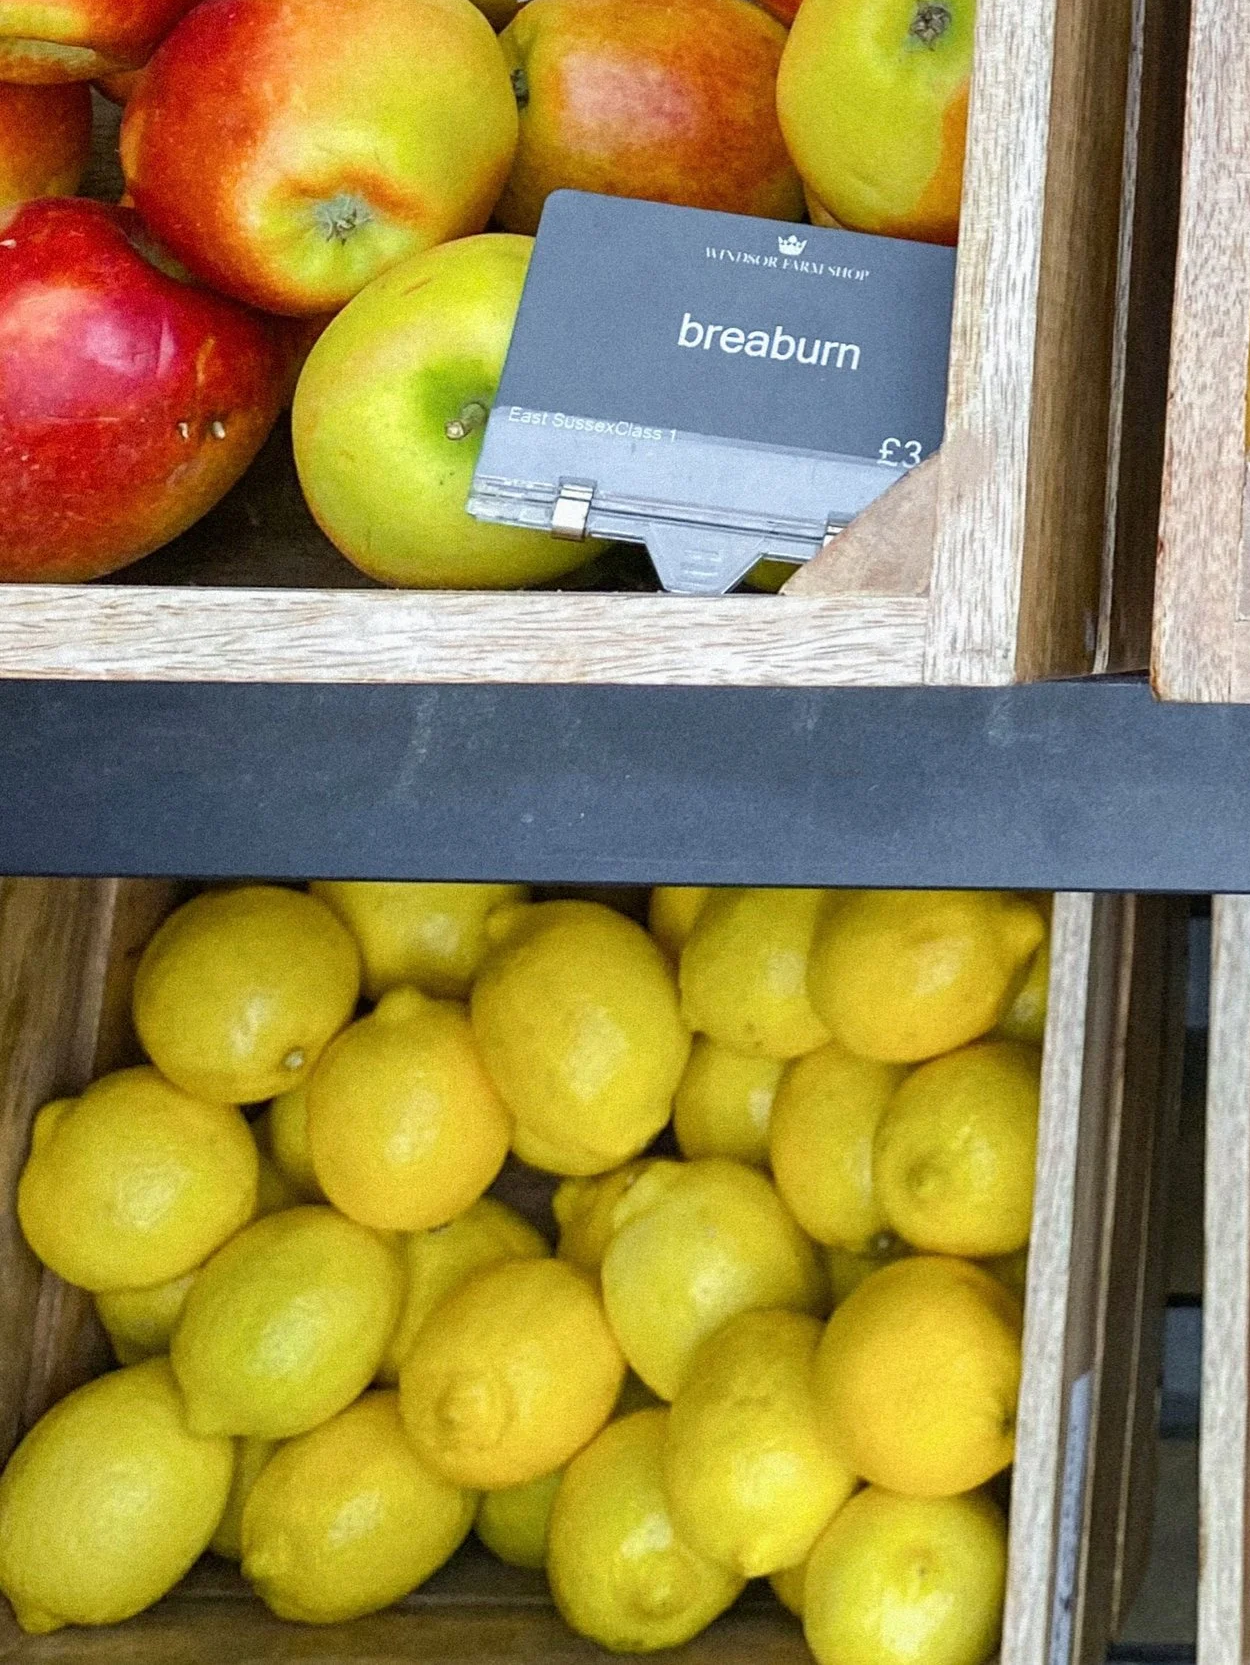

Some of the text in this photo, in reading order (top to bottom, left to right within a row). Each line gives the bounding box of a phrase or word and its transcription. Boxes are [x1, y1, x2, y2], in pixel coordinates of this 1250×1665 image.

[705, 246, 870, 282] WINDSOR FARM SHOP
[677, 313, 861, 371] breaburn
[508, 406, 548, 426] East
[668, 429, 678, 442] 1
